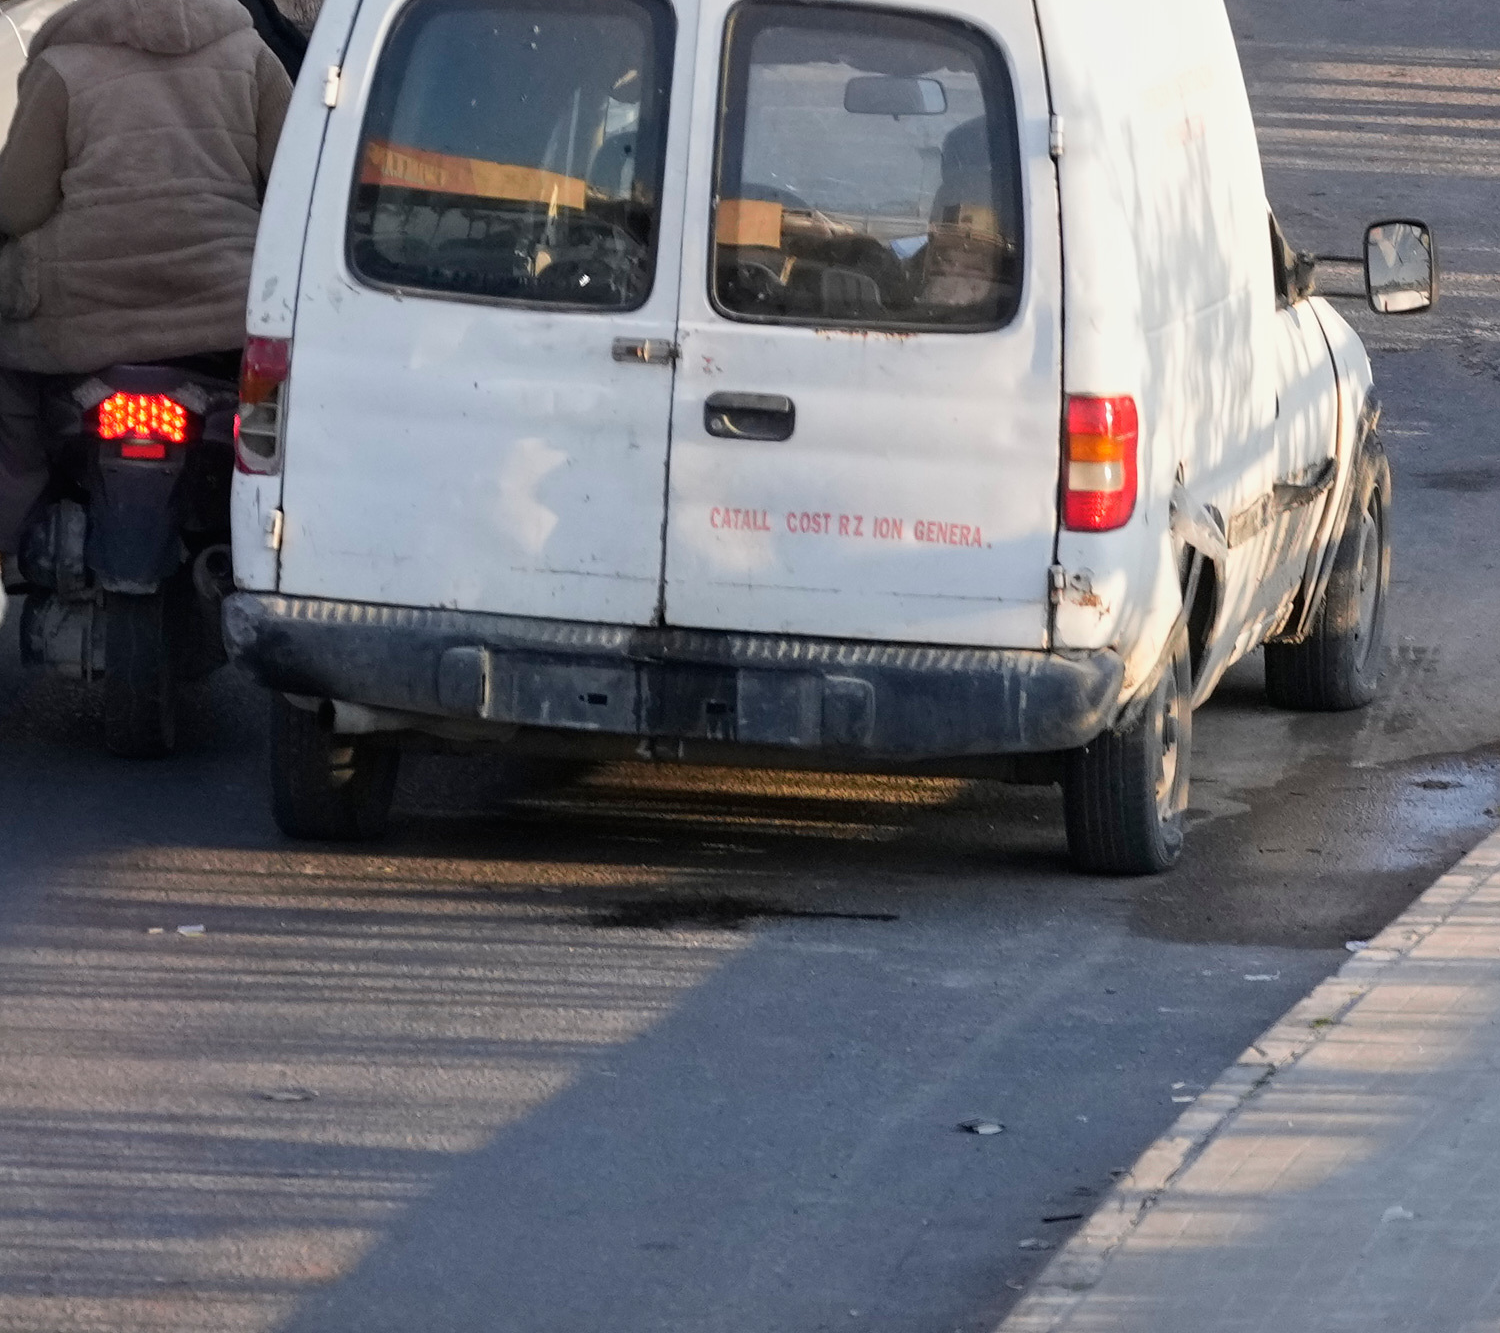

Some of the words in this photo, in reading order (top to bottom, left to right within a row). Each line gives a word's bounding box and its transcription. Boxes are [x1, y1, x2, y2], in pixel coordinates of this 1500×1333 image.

[709, 505, 772, 532] CATALL
[786, 508, 833, 535] COST
[872, 515, 904, 539] ION
